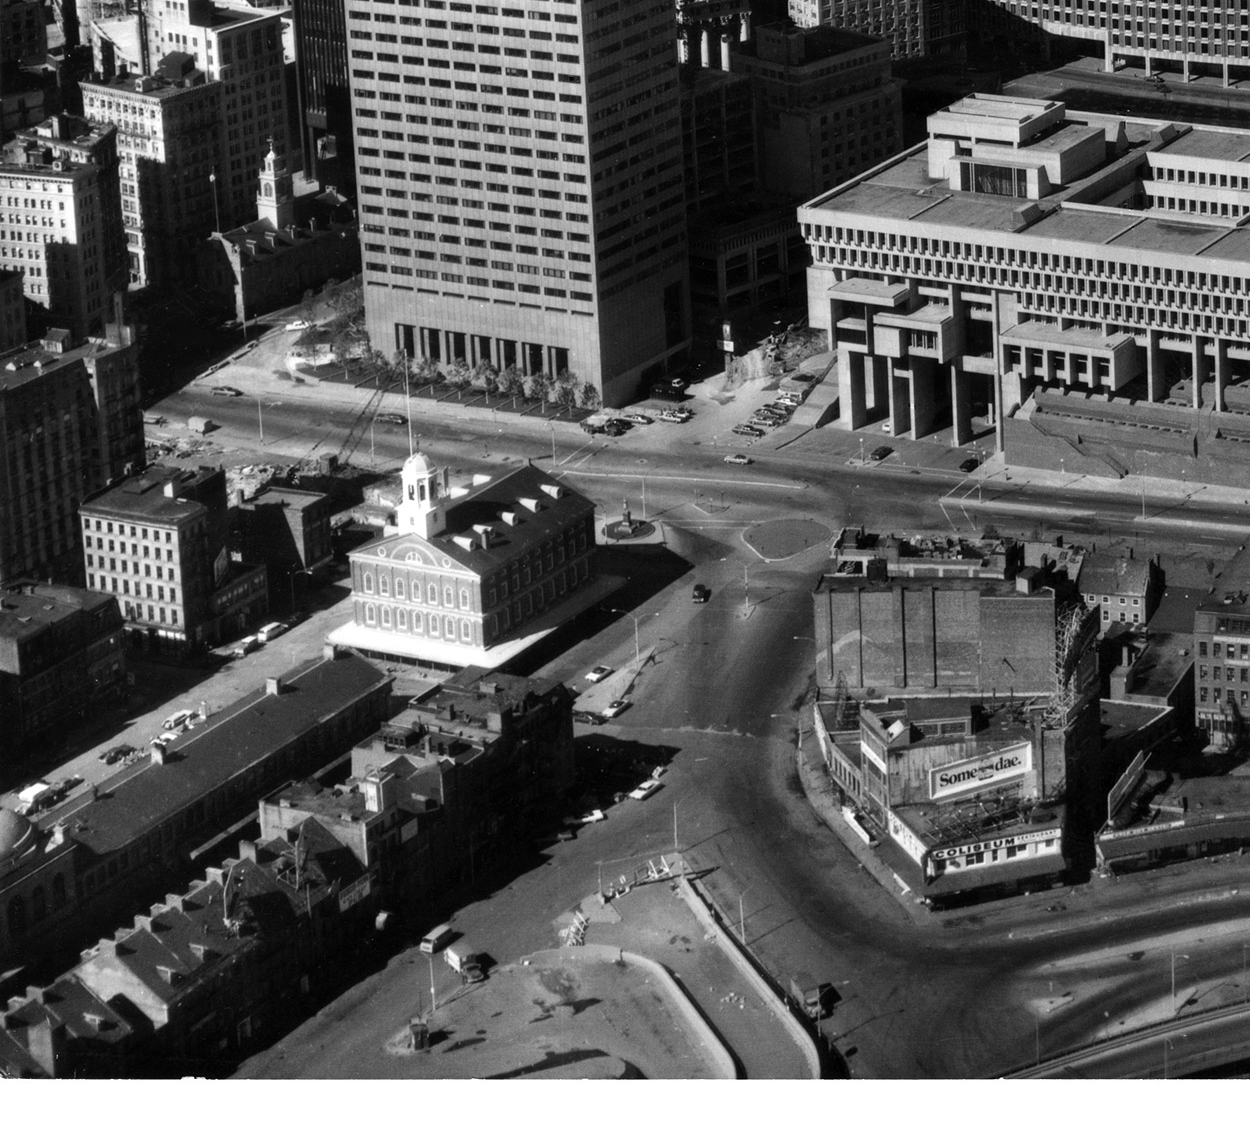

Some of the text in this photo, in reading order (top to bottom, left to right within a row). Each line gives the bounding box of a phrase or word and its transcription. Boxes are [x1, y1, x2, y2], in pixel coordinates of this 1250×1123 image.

[940, 756, 1021, 787] Some dae.
[935, 830, 1056, 859] COLISEUM RESTAURANT
